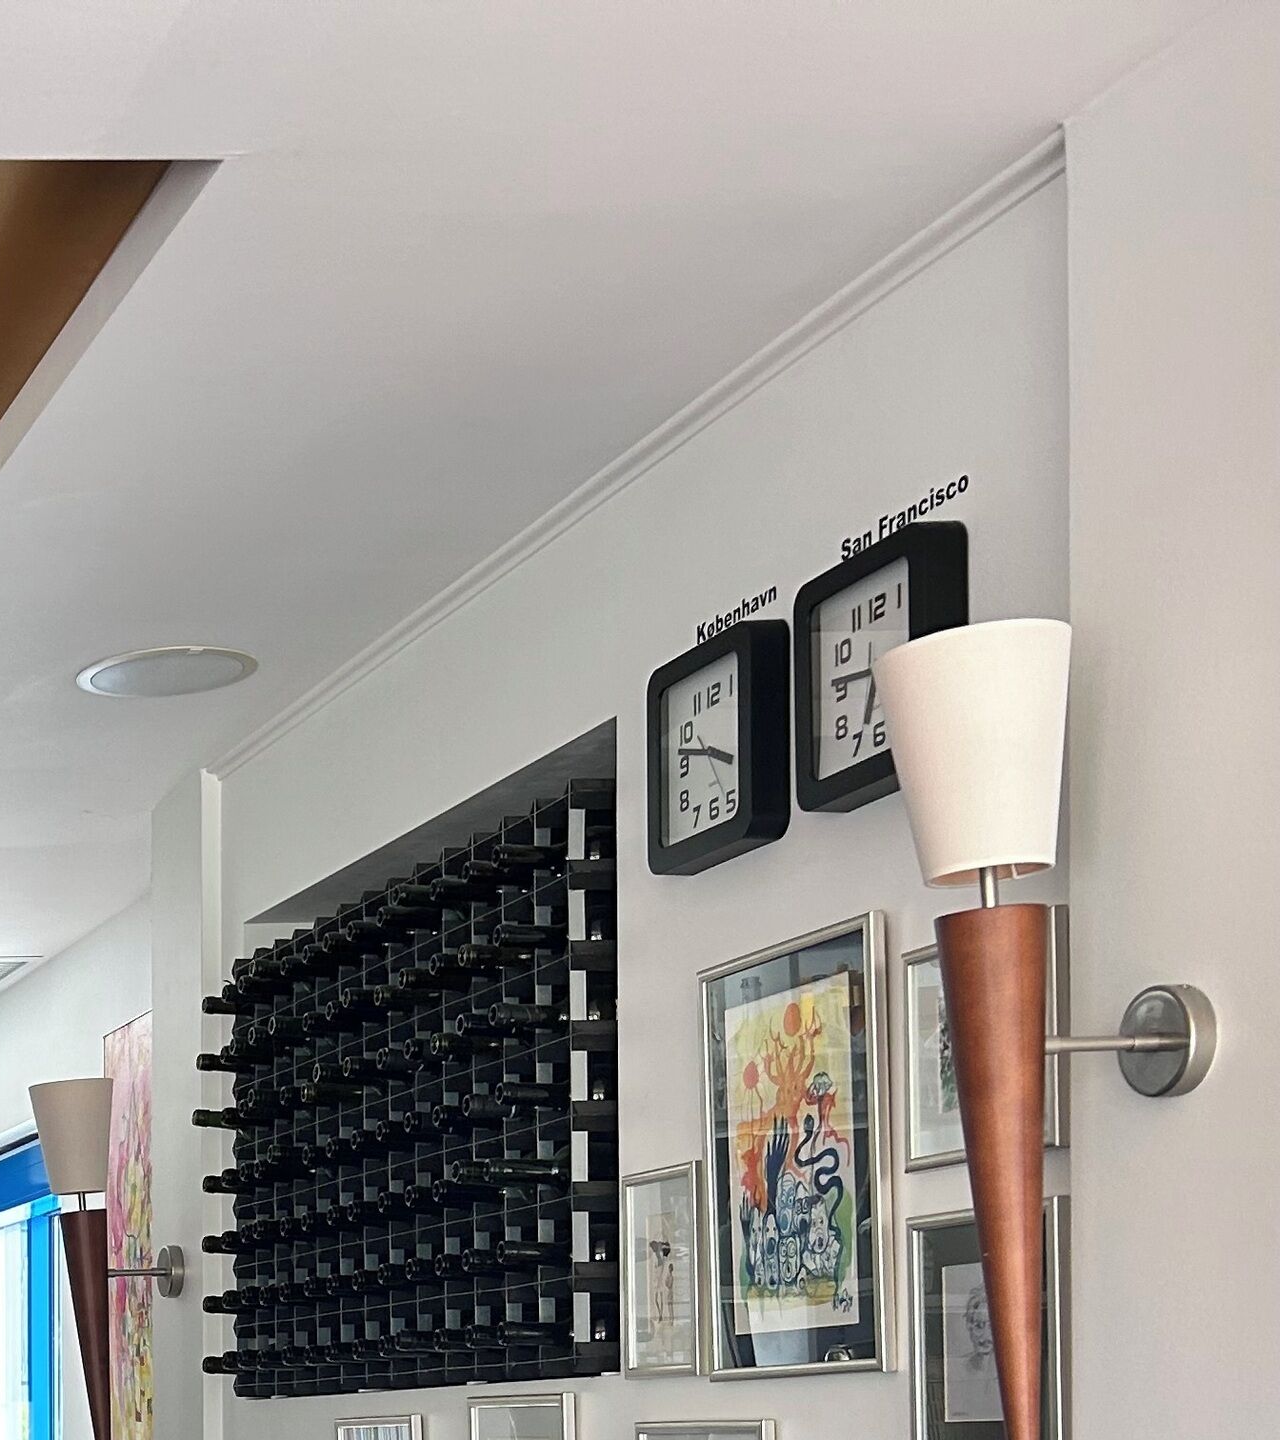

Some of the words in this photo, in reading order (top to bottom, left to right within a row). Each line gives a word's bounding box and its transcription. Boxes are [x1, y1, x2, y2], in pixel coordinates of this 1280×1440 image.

[841, 530, 872, 562] San
[879, 474, 969, 541] Francisco
[696, 585, 777, 645] København
[852, 604, 862, 633] 11
[869, 592, 887, 624] 12
[835, 638, 852, 667] 10
[693, 691, 701, 717] 11
[707, 682, 721, 709] 12
[680, 721, 693, 746] 10
[835, 714, 848, 741] 8
[873, 720, 886, 748] 6
[852, 730, 864, 757] 7
[680, 754, 690, 779] 9
[680, 789, 690, 812] 8
[709, 796, 720, 821] 6
[726, 788, 736, 814] 5
[692, 804, 702, 828] 7
